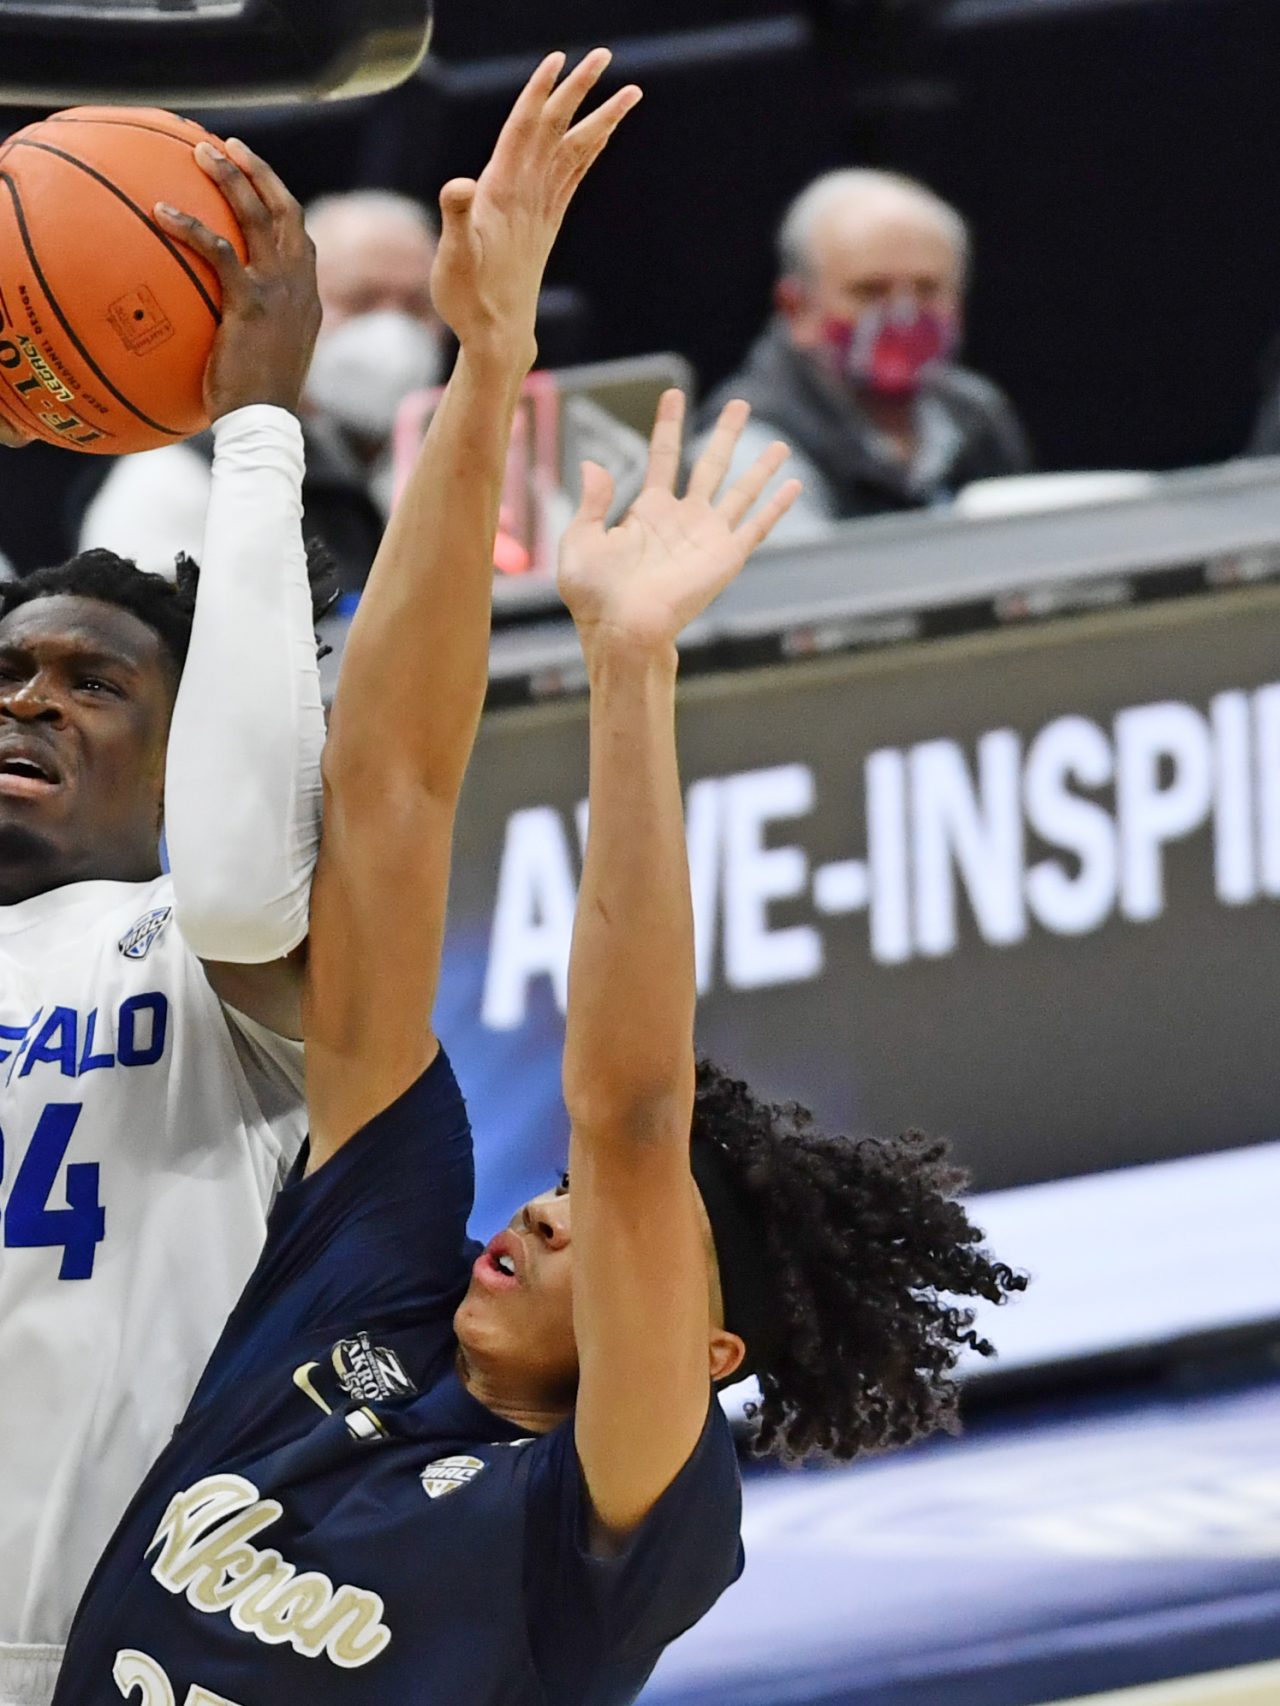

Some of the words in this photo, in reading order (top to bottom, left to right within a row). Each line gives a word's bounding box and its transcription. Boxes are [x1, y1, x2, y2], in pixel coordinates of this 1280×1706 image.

[18, 284, 43, 335] DESIGN
[16, 333, 74, 402] LEGACY
[41, 339, 82, 392] CHANNEL
[78, 393, 109, 415] DEEP
[480, 682, 1280, 1031] AE-INSPI
[419, 1464, 478, 1482] MAC
[144, 1473, 391, 1668] Akron
